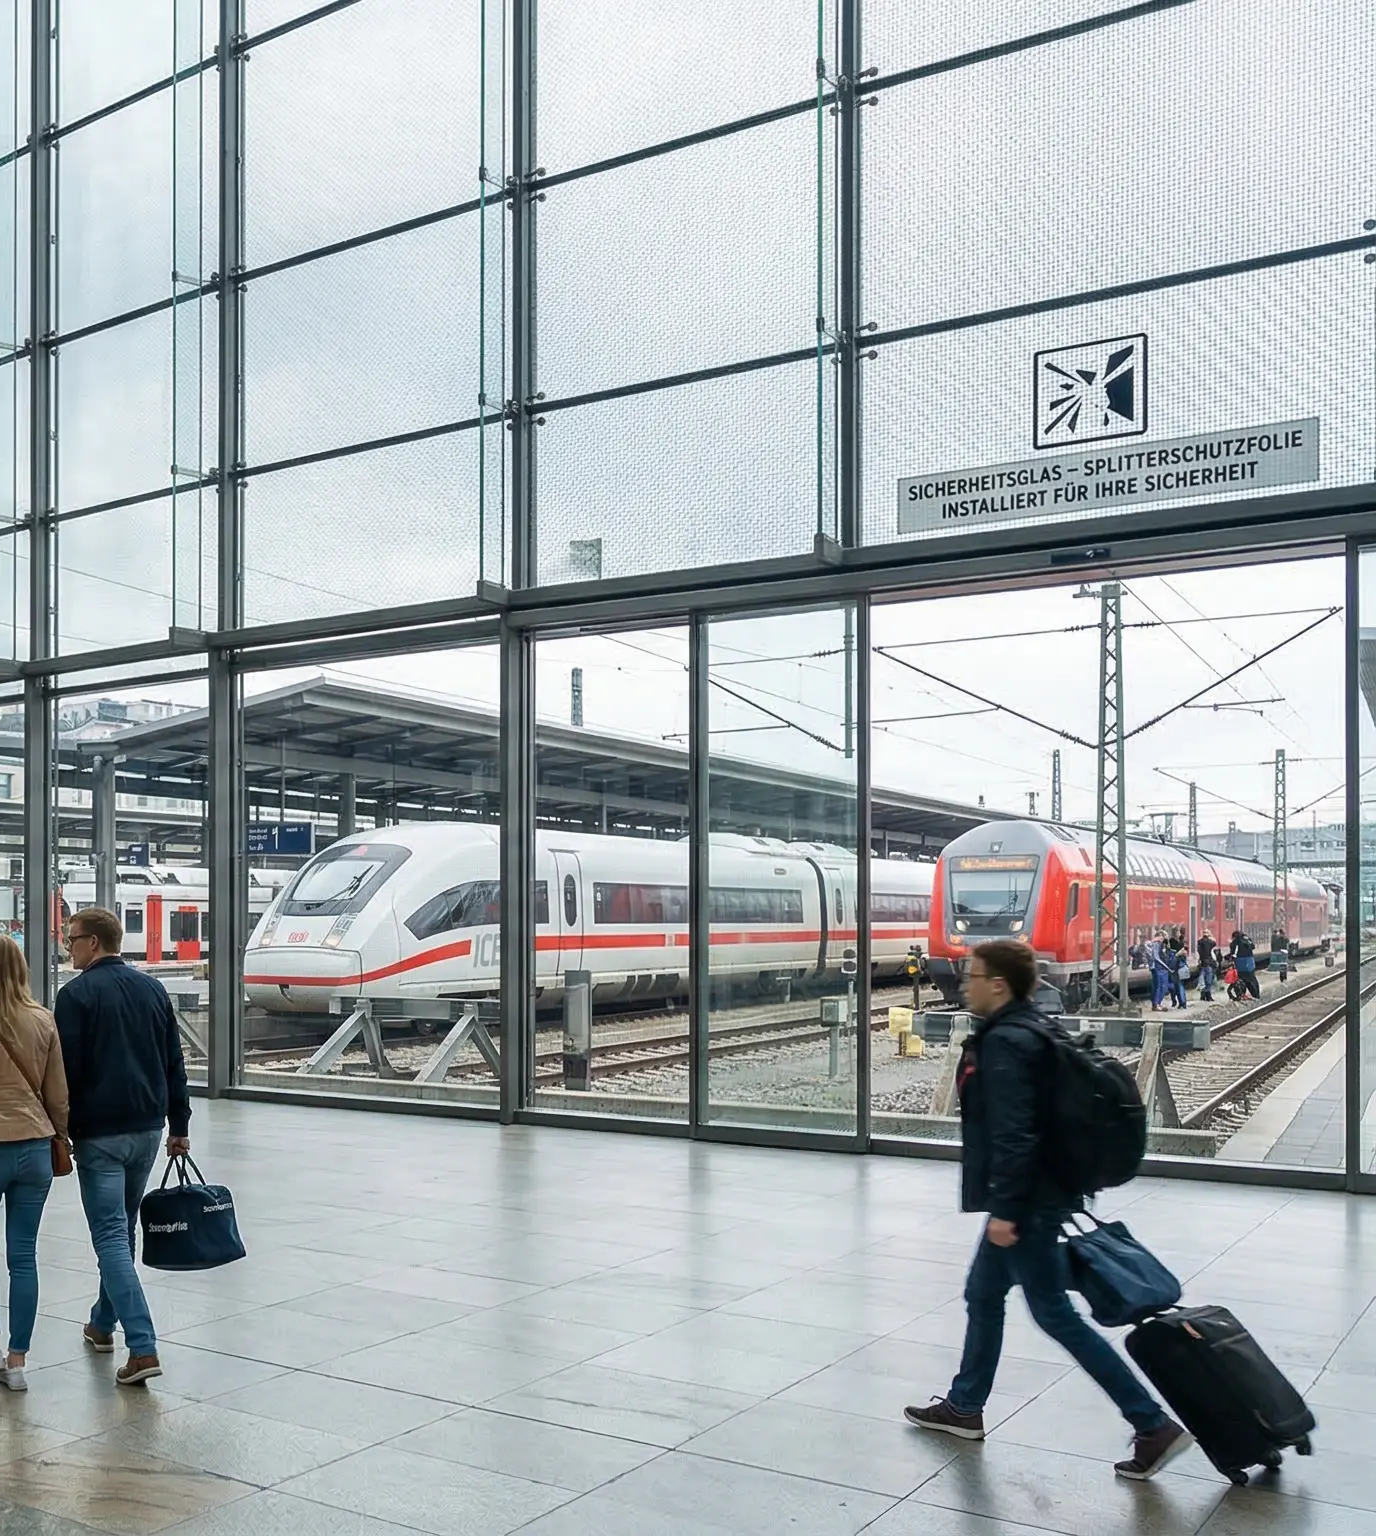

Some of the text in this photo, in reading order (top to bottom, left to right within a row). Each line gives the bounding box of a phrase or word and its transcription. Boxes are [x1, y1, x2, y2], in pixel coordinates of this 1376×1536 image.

[908, 464, 1062, 501] SICHERHEITSGLAS
[1083, 430, 1304, 478] SPLITTERSCHUTZFOLIE
[942, 461, 1259, 520] INSTALLIERT FÜR IHRE SICHERHEIT
[473, 933, 501, 968] ICE
